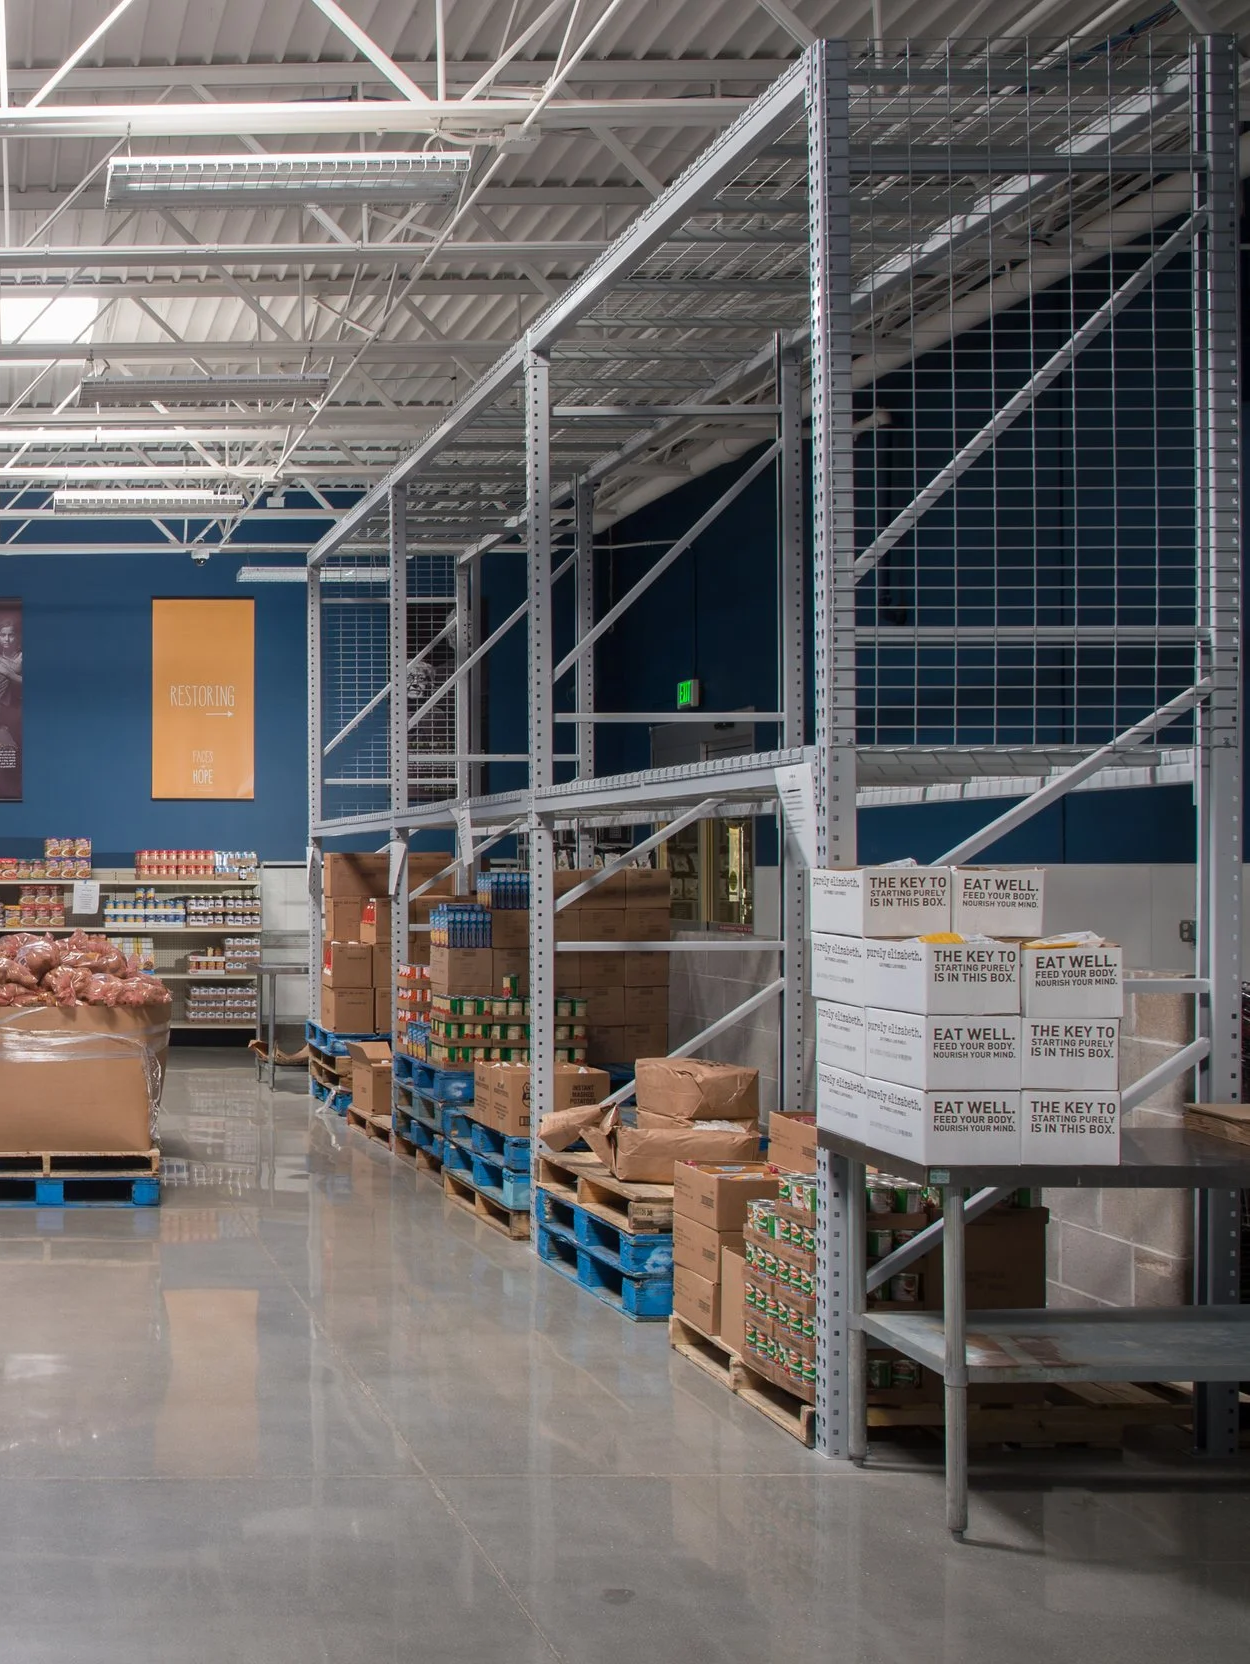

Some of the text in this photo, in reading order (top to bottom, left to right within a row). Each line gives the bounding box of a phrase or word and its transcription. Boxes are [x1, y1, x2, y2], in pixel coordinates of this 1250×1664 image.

[170, 685, 235, 707] RESTORING
[680, 681, 691, 704] EXIT
[192, 769, 214, 784] HOPE
[813, 876, 860, 888] purely elizabeth.
[870, 877, 947, 888] THE KEY TO
[964, 879, 1039, 891] EAT WELL.
[870, 889, 946, 897] STARTING PURELY
[963, 891, 1038, 901] FEED YOUR BODY.
[870, 898, 946, 907] IS IN THIS BOX.
[814, 942, 862, 958] purely elizabeth.
[867, 948, 922, 961] purely elizabeth.
[934, 951, 1016, 962] THE KEY TO
[1036, 955, 1117, 969] EAT WELL.
[934, 973, 1016, 982] IS IN THIS BOX.
[1035, 969, 1117, 978] FEED YOUR BODY.
[818, 1008, 863, 1026] purely elizabeth.
[868, 1022, 922, 1038] purely elizabeth.
[934, 1028, 1015, 1040] EAT WELL.
[1031, 1025, 1115, 1038] THE KEY TO
[933, 1042, 1015, 1050] FEED YOUR BODY.
[1031, 1038, 1076, 1046] STARTING
[1031, 1047, 1114, 1058] IS IN THIS BOX.
[819, 1073, 835, 1086] purely
[836, 1077, 866, 1094] elizabeth.
[867, 1088, 887, 1103] purely
[888, 1093, 922, 1111] elizabeth.
[934, 1101, 1016, 1114] EAT WELL.
[1031, 1101, 1116, 1114] THE KEY TO
[1079, 1115, 1115, 1123] PURELY
[1031, 1123, 1115, 1134] IS IN THIS BOX.
